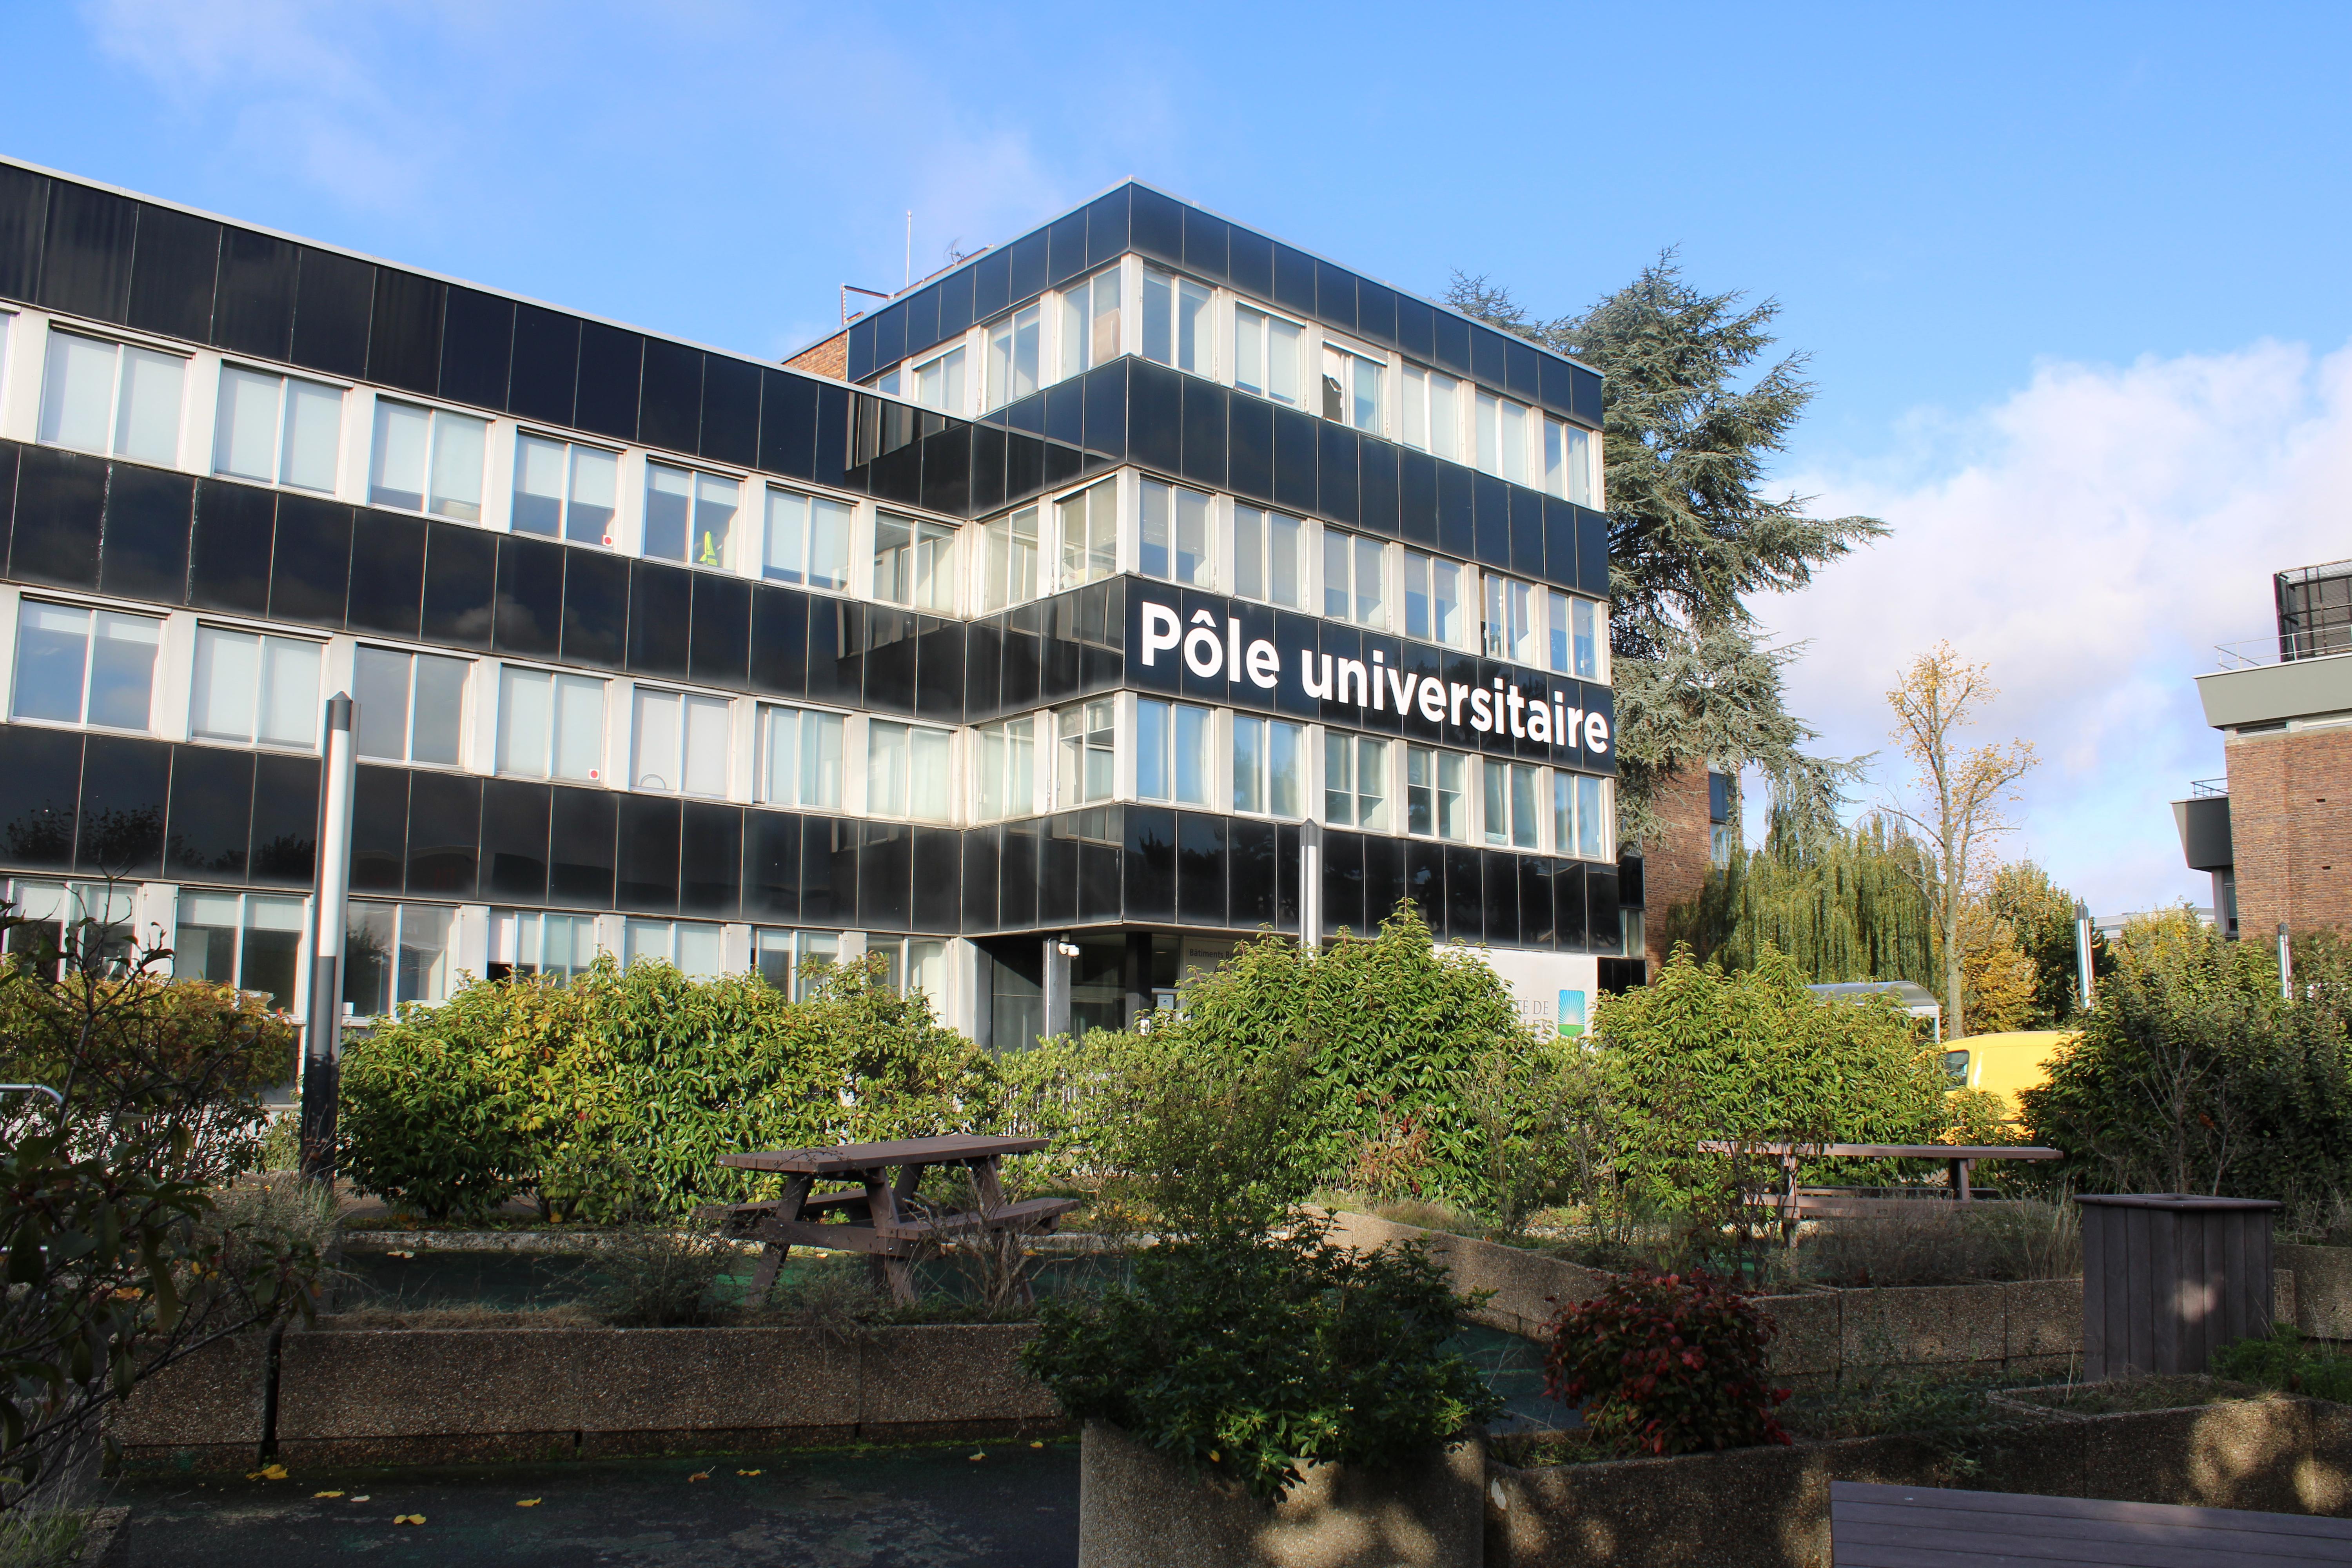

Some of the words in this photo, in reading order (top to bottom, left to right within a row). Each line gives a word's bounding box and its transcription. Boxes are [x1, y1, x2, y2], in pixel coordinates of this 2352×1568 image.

[1142, 601, 1280, 689] Pôle
[1301, 649, 1609, 754] universitaire
[1189, 948, 1223, 958] Bâtiments
[1533, 1000, 1549, 1014] DE
